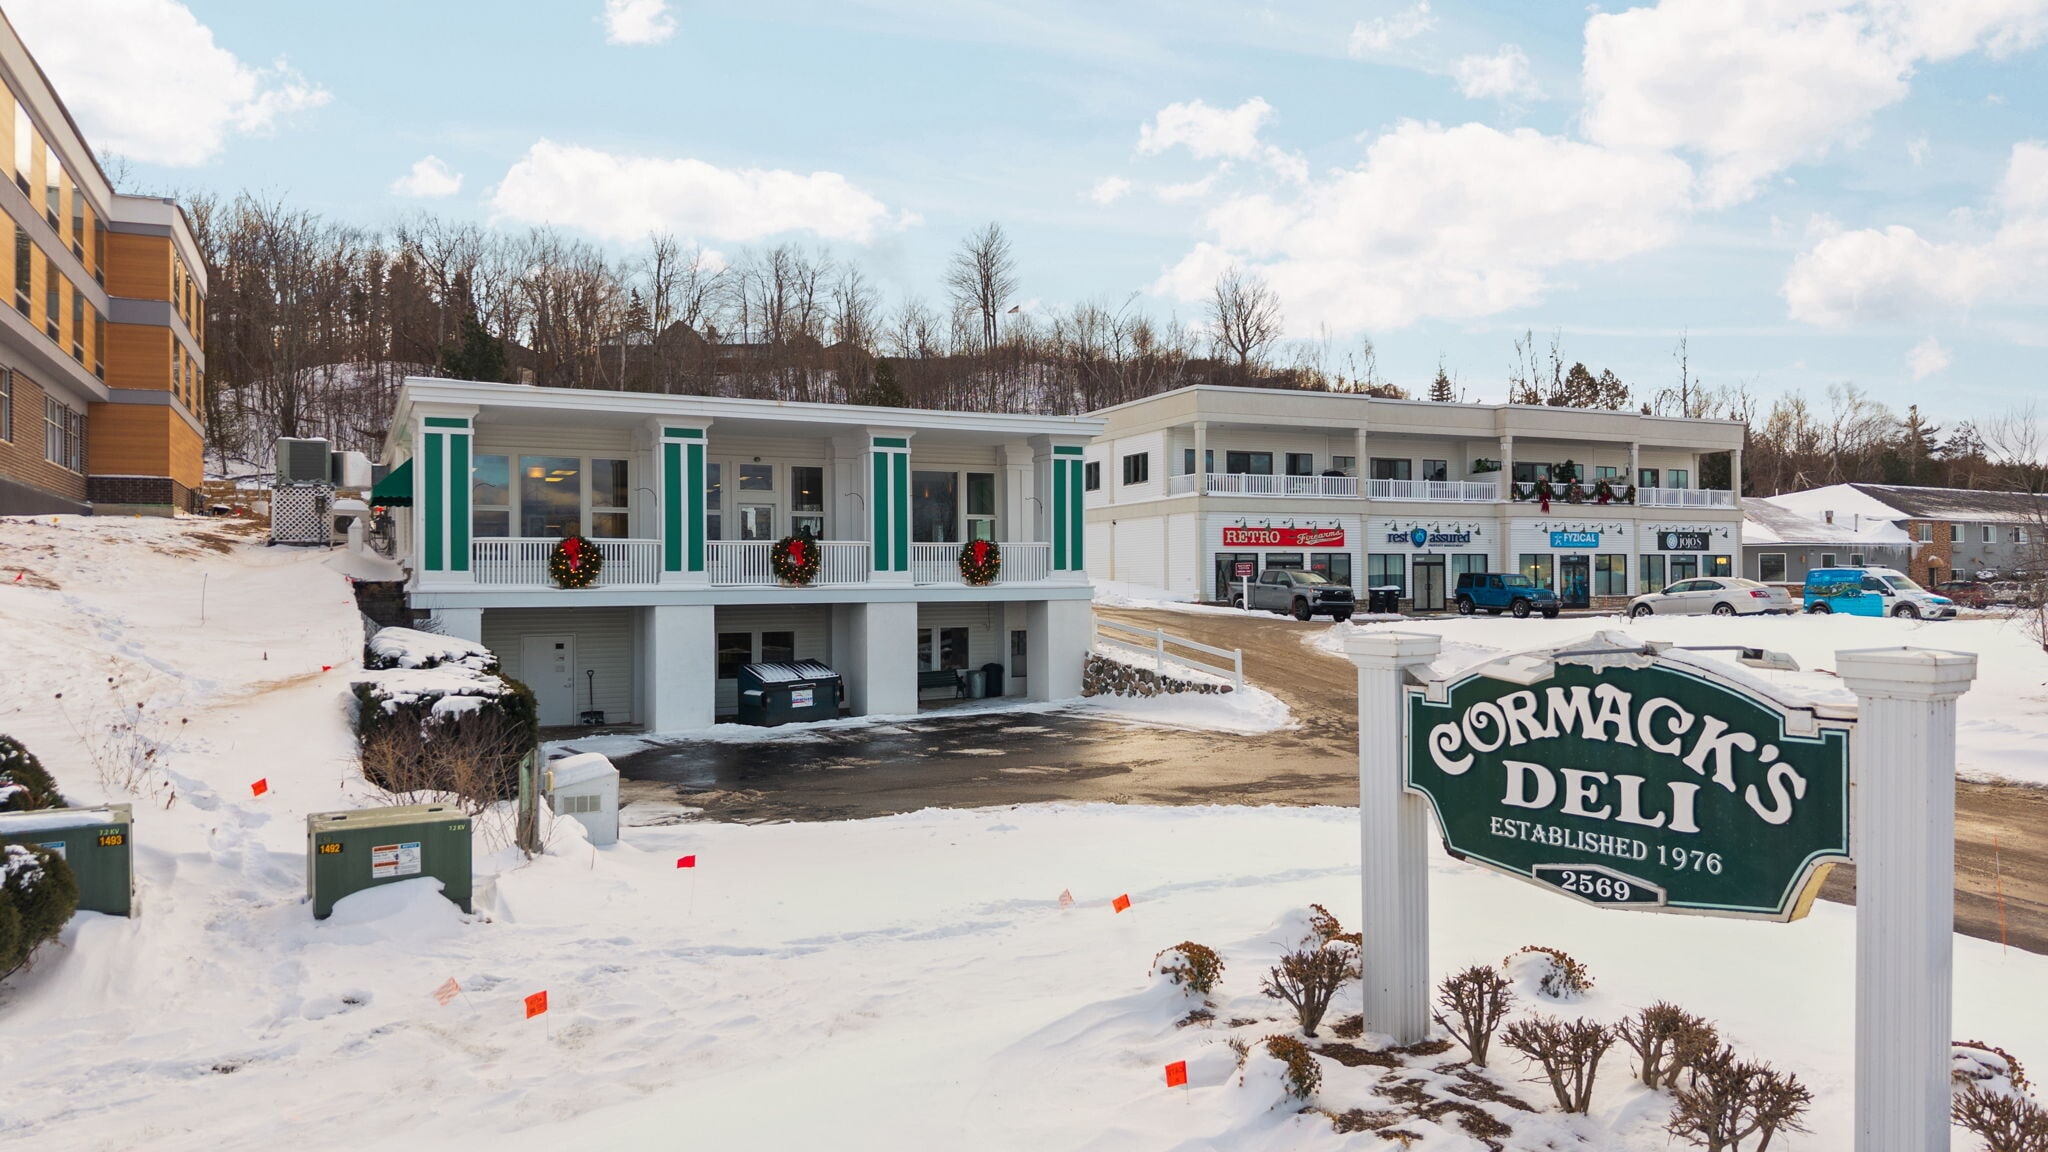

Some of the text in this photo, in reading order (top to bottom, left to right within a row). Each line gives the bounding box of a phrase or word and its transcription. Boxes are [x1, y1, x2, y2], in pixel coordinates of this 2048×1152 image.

[1225, 530, 1343, 545] RETRO Firearms
[1387, 530, 1471, 543] rest assured
[1563, 533, 1597, 543] FYZICAL
[1428, 683, 1807, 825] CORMACK'S
[1500, 760, 1701, 833] DELI
[99, 835, 122, 846] 1493
[1490, 816, 1723, 876] ESTABLISHED 1976
[320, 843, 340, 854] 1492
[1561, 870, 1630, 902] 2569
